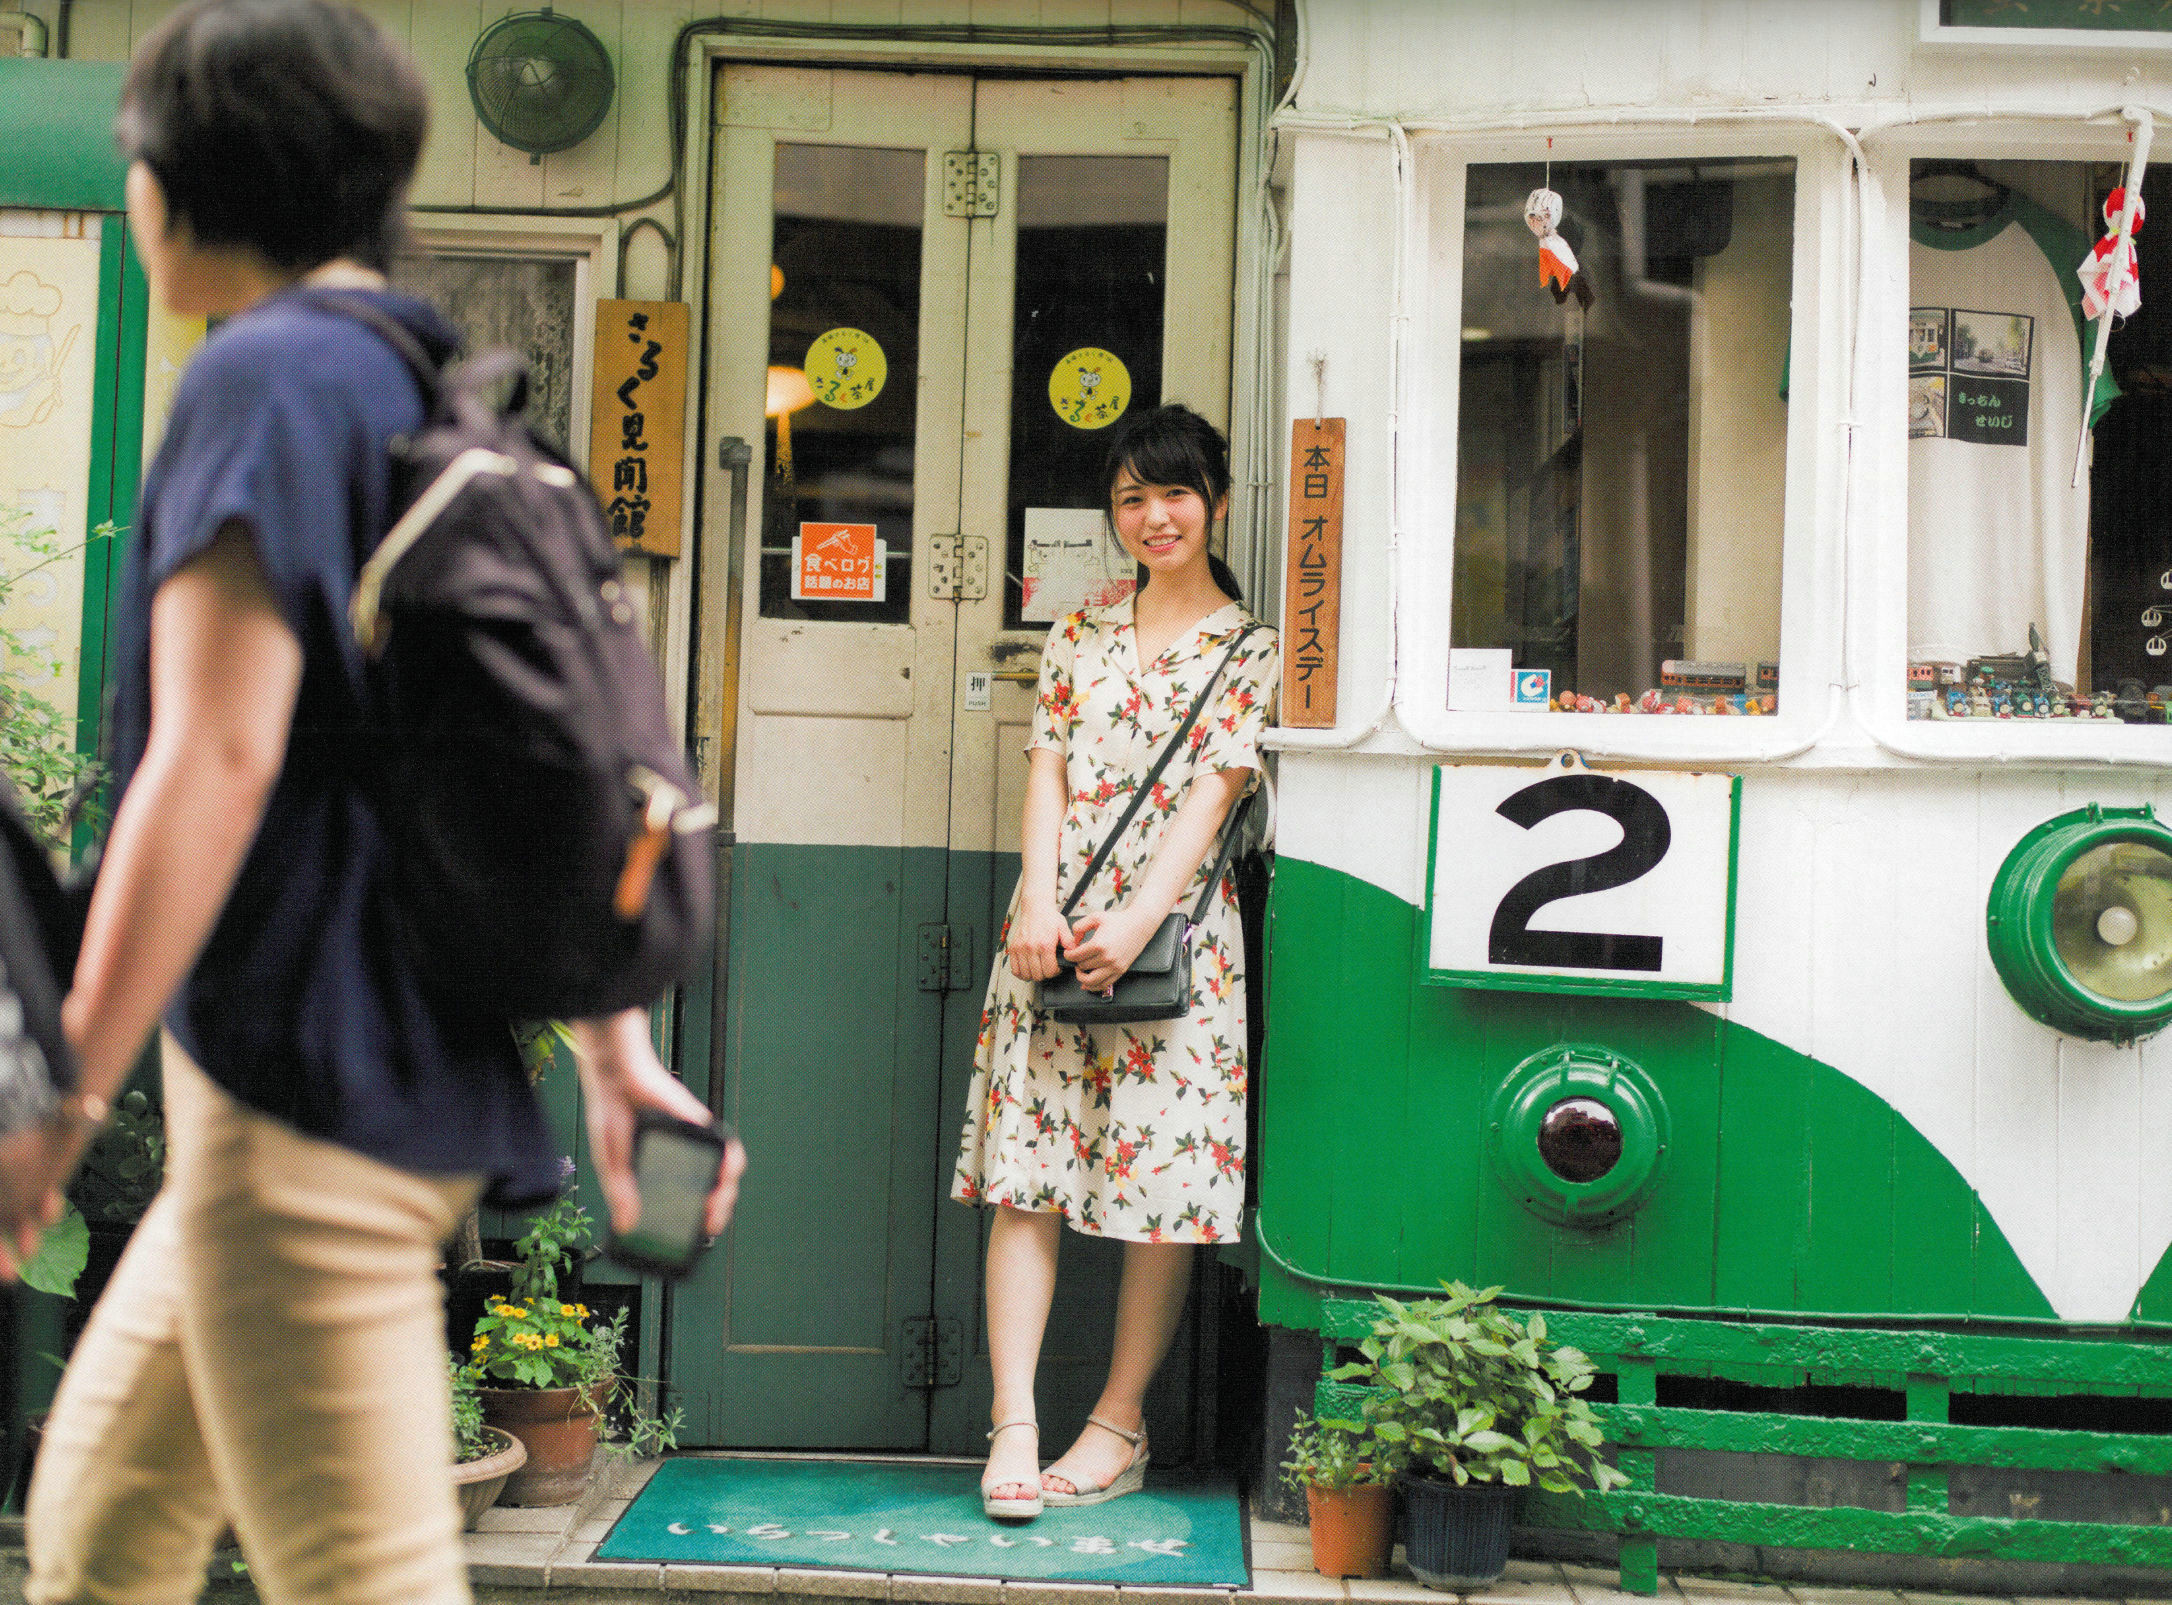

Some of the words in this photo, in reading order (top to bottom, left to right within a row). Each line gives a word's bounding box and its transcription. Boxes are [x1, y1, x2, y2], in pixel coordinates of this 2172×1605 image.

[608, 312, 662, 539] さるく見聞館
[1303, 445, 1331, 499] 本日
[804, 553, 871, 574] 食べログ
[1296, 515, 1329, 709] オムライスデー
[970, 676, 986, 692] 押
[1488, 774, 1671, 972] 2
[666, 1522, 1190, 1558] いらっしゃいませ
